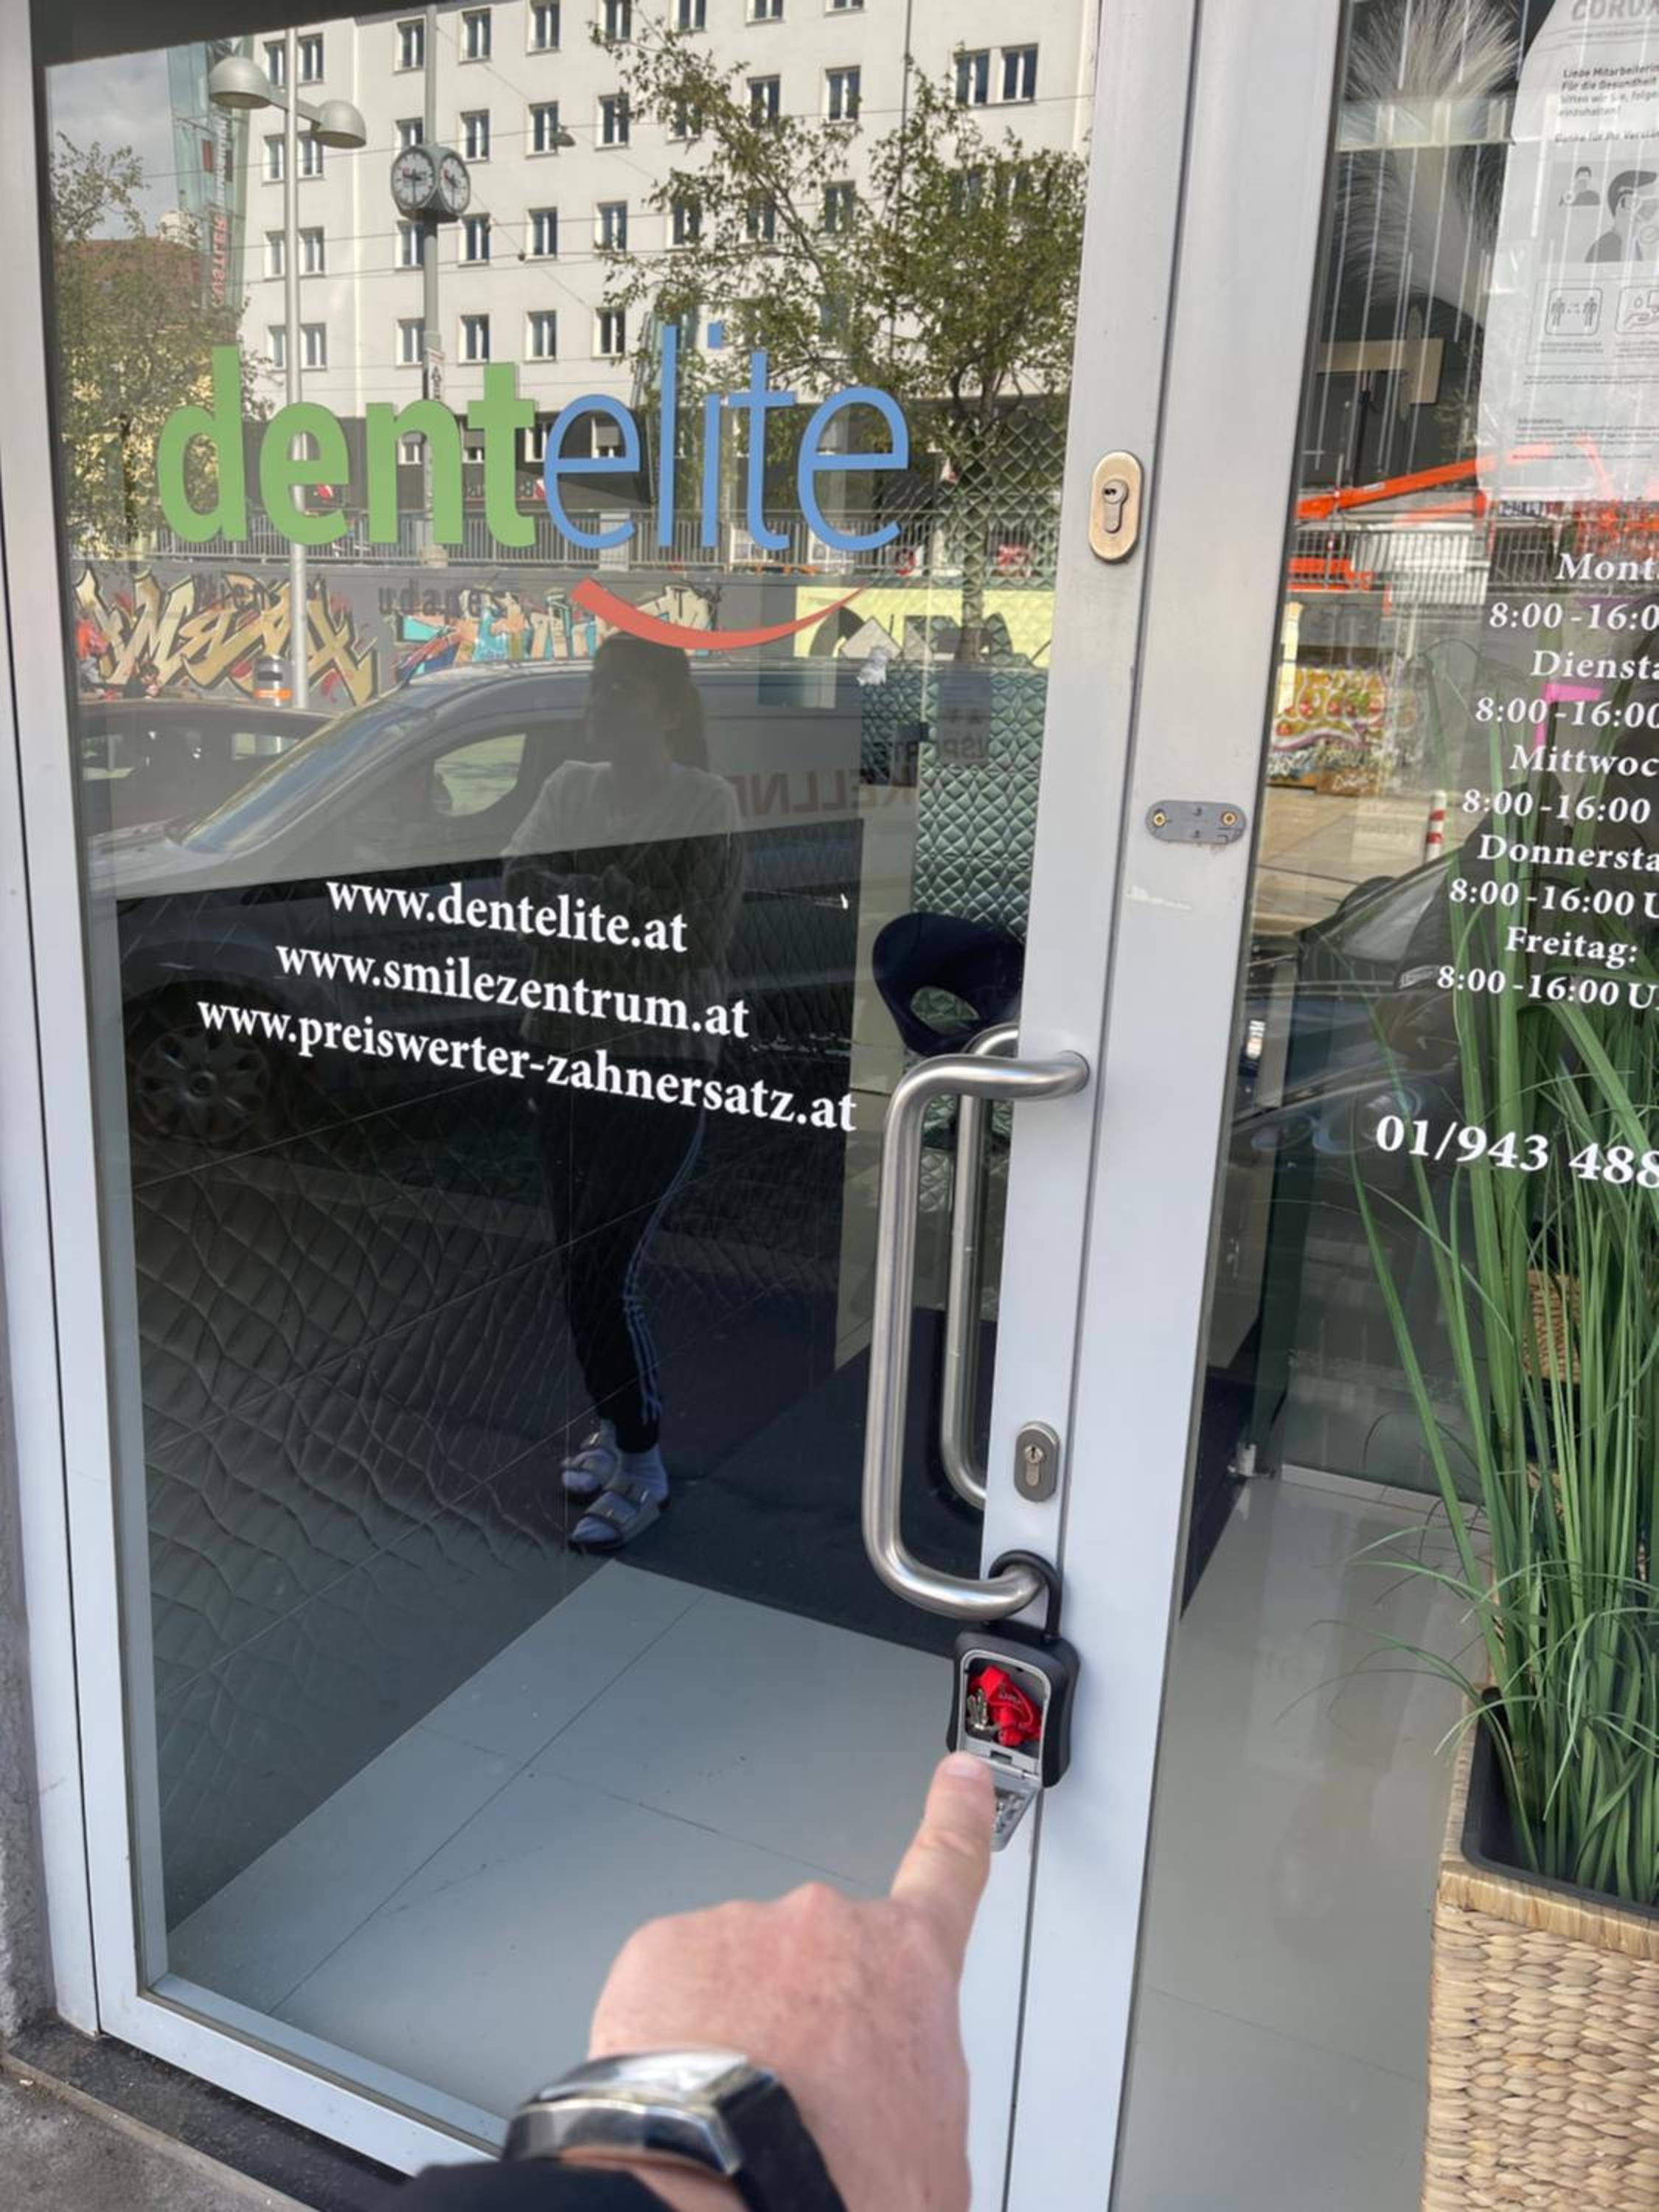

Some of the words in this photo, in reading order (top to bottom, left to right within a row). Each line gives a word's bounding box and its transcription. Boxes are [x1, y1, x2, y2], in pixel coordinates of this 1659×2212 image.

[156, 321, 909, 552] dentelite
[1554, 552, 1659, 581] Mont
[1509, 744, 1659, 778] Mittwoc
[327, 880, 688, 954] www.dentelite.at
[1505, 926, 1638, 970] Freitag:
[276, 942, 750, 1040] www.smilezentrum.at
[1627, 981, 1659, 1010] U
[196, 998, 857, 1133] www.preiswerter-zahnersatz.at
[1375, 1114, 1548, 1172] 01/943
[1568, 1142, 1659, 1189] 488
